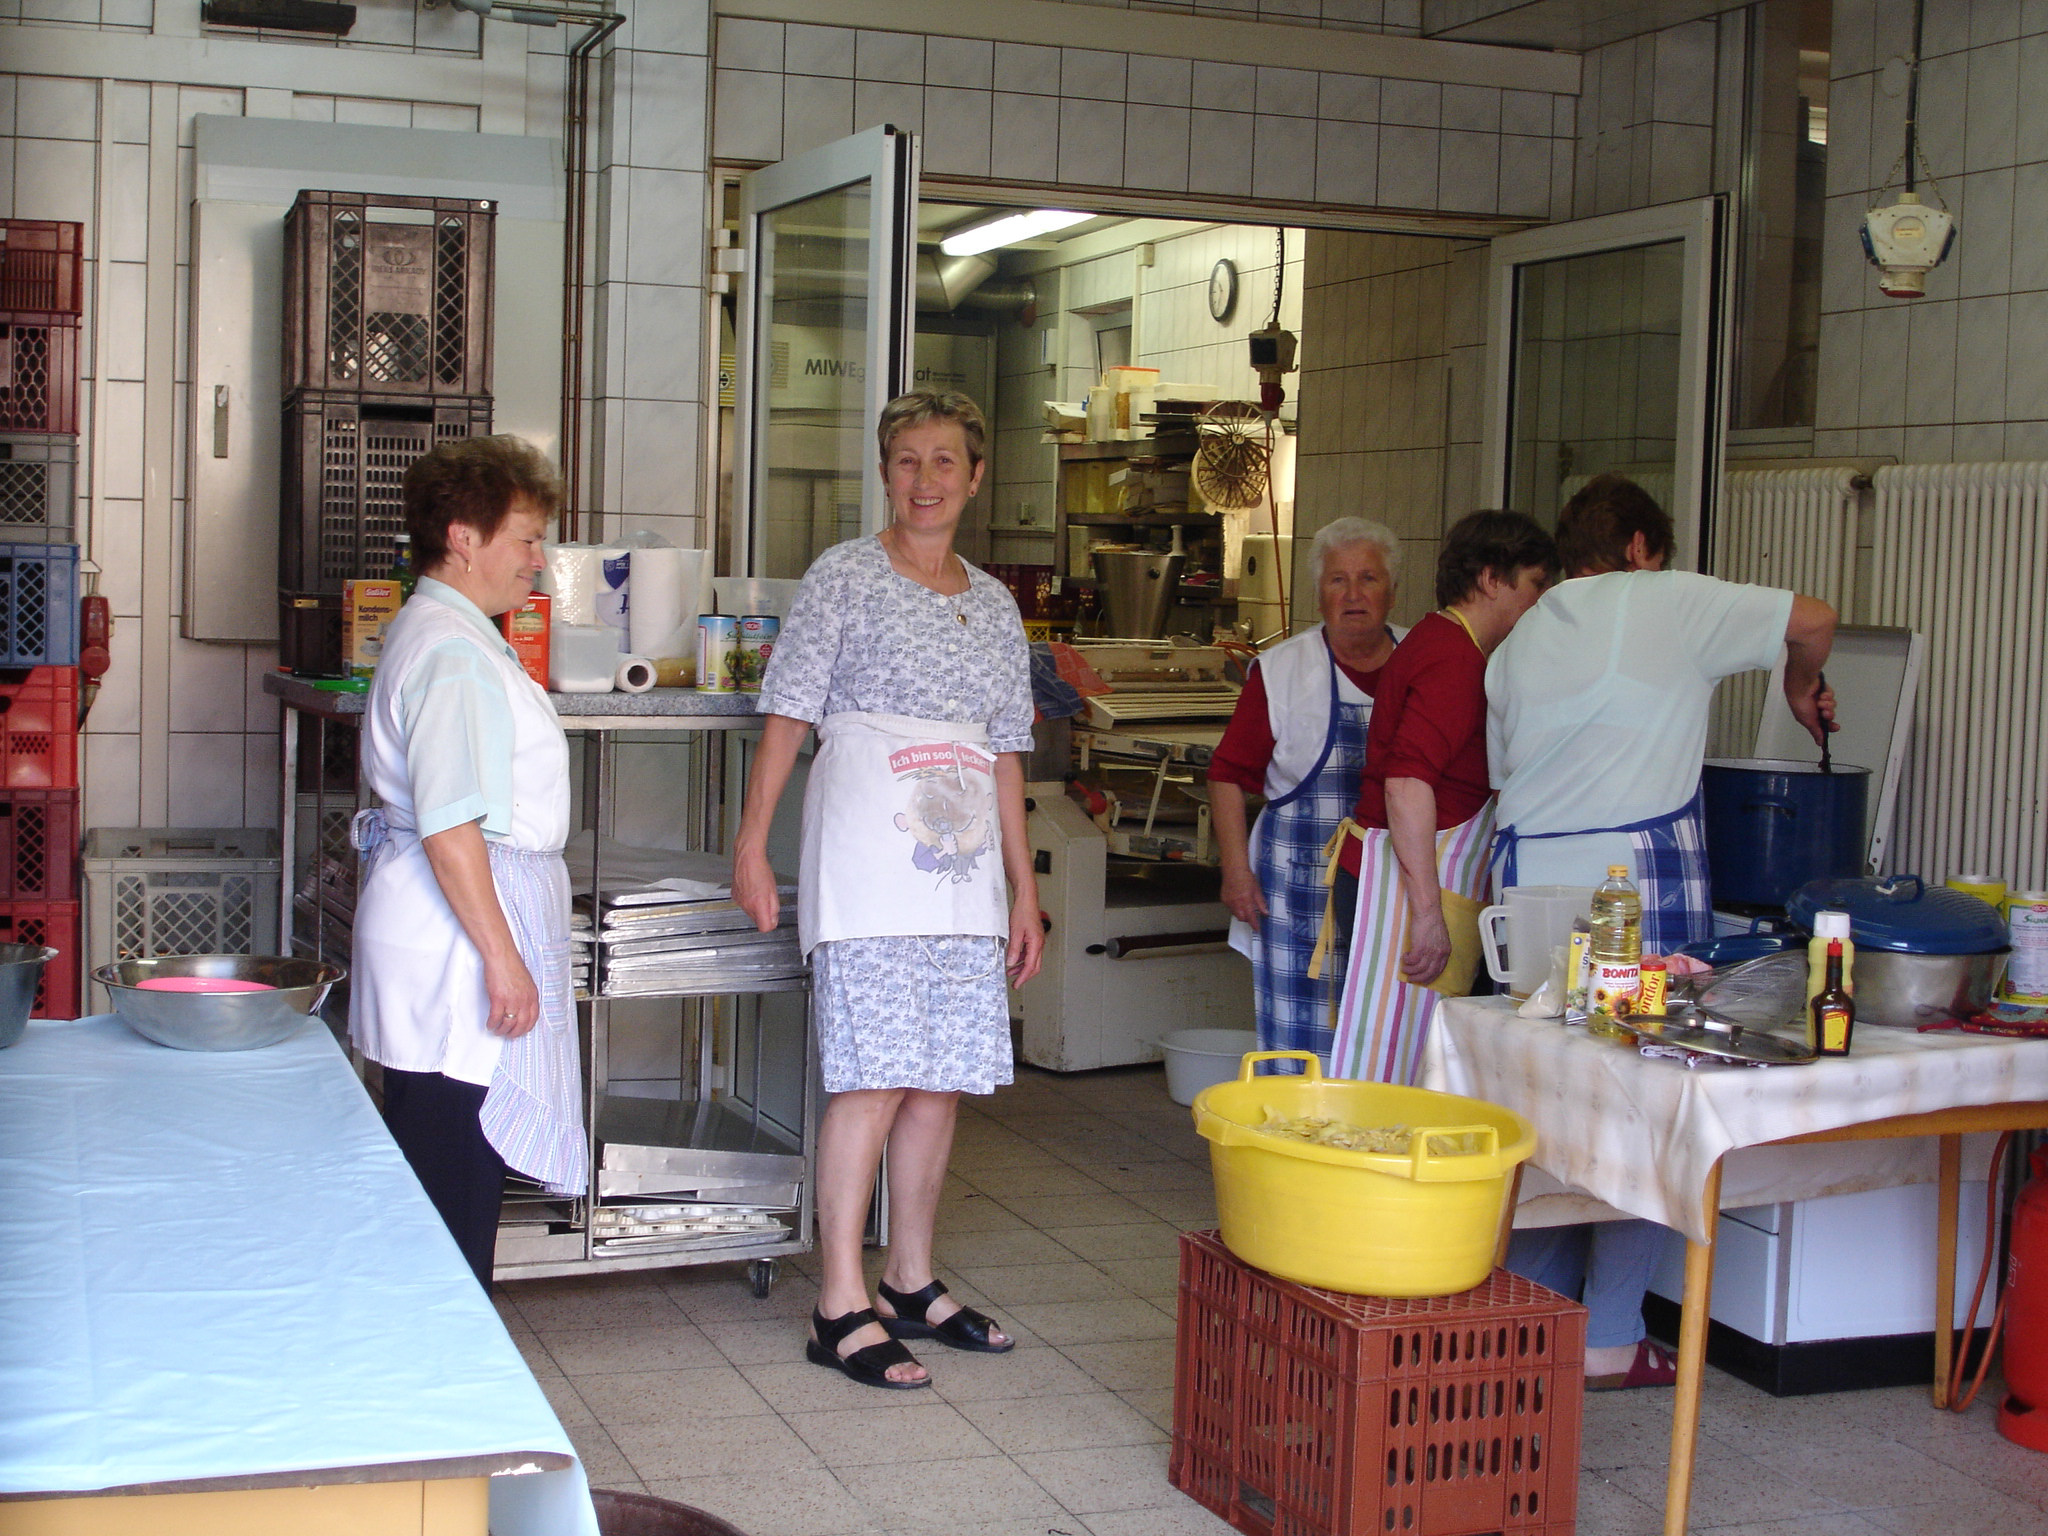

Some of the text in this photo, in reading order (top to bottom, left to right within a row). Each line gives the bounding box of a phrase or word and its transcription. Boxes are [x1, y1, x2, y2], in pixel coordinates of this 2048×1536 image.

[358, 605, 393, 614] Kondens-
[358, 613, 379, 622] milch
[892, 754, 910, 769] Ich
[911, 751, 931, 763] bin
[1640, 973, 1660, 1014] ondor
